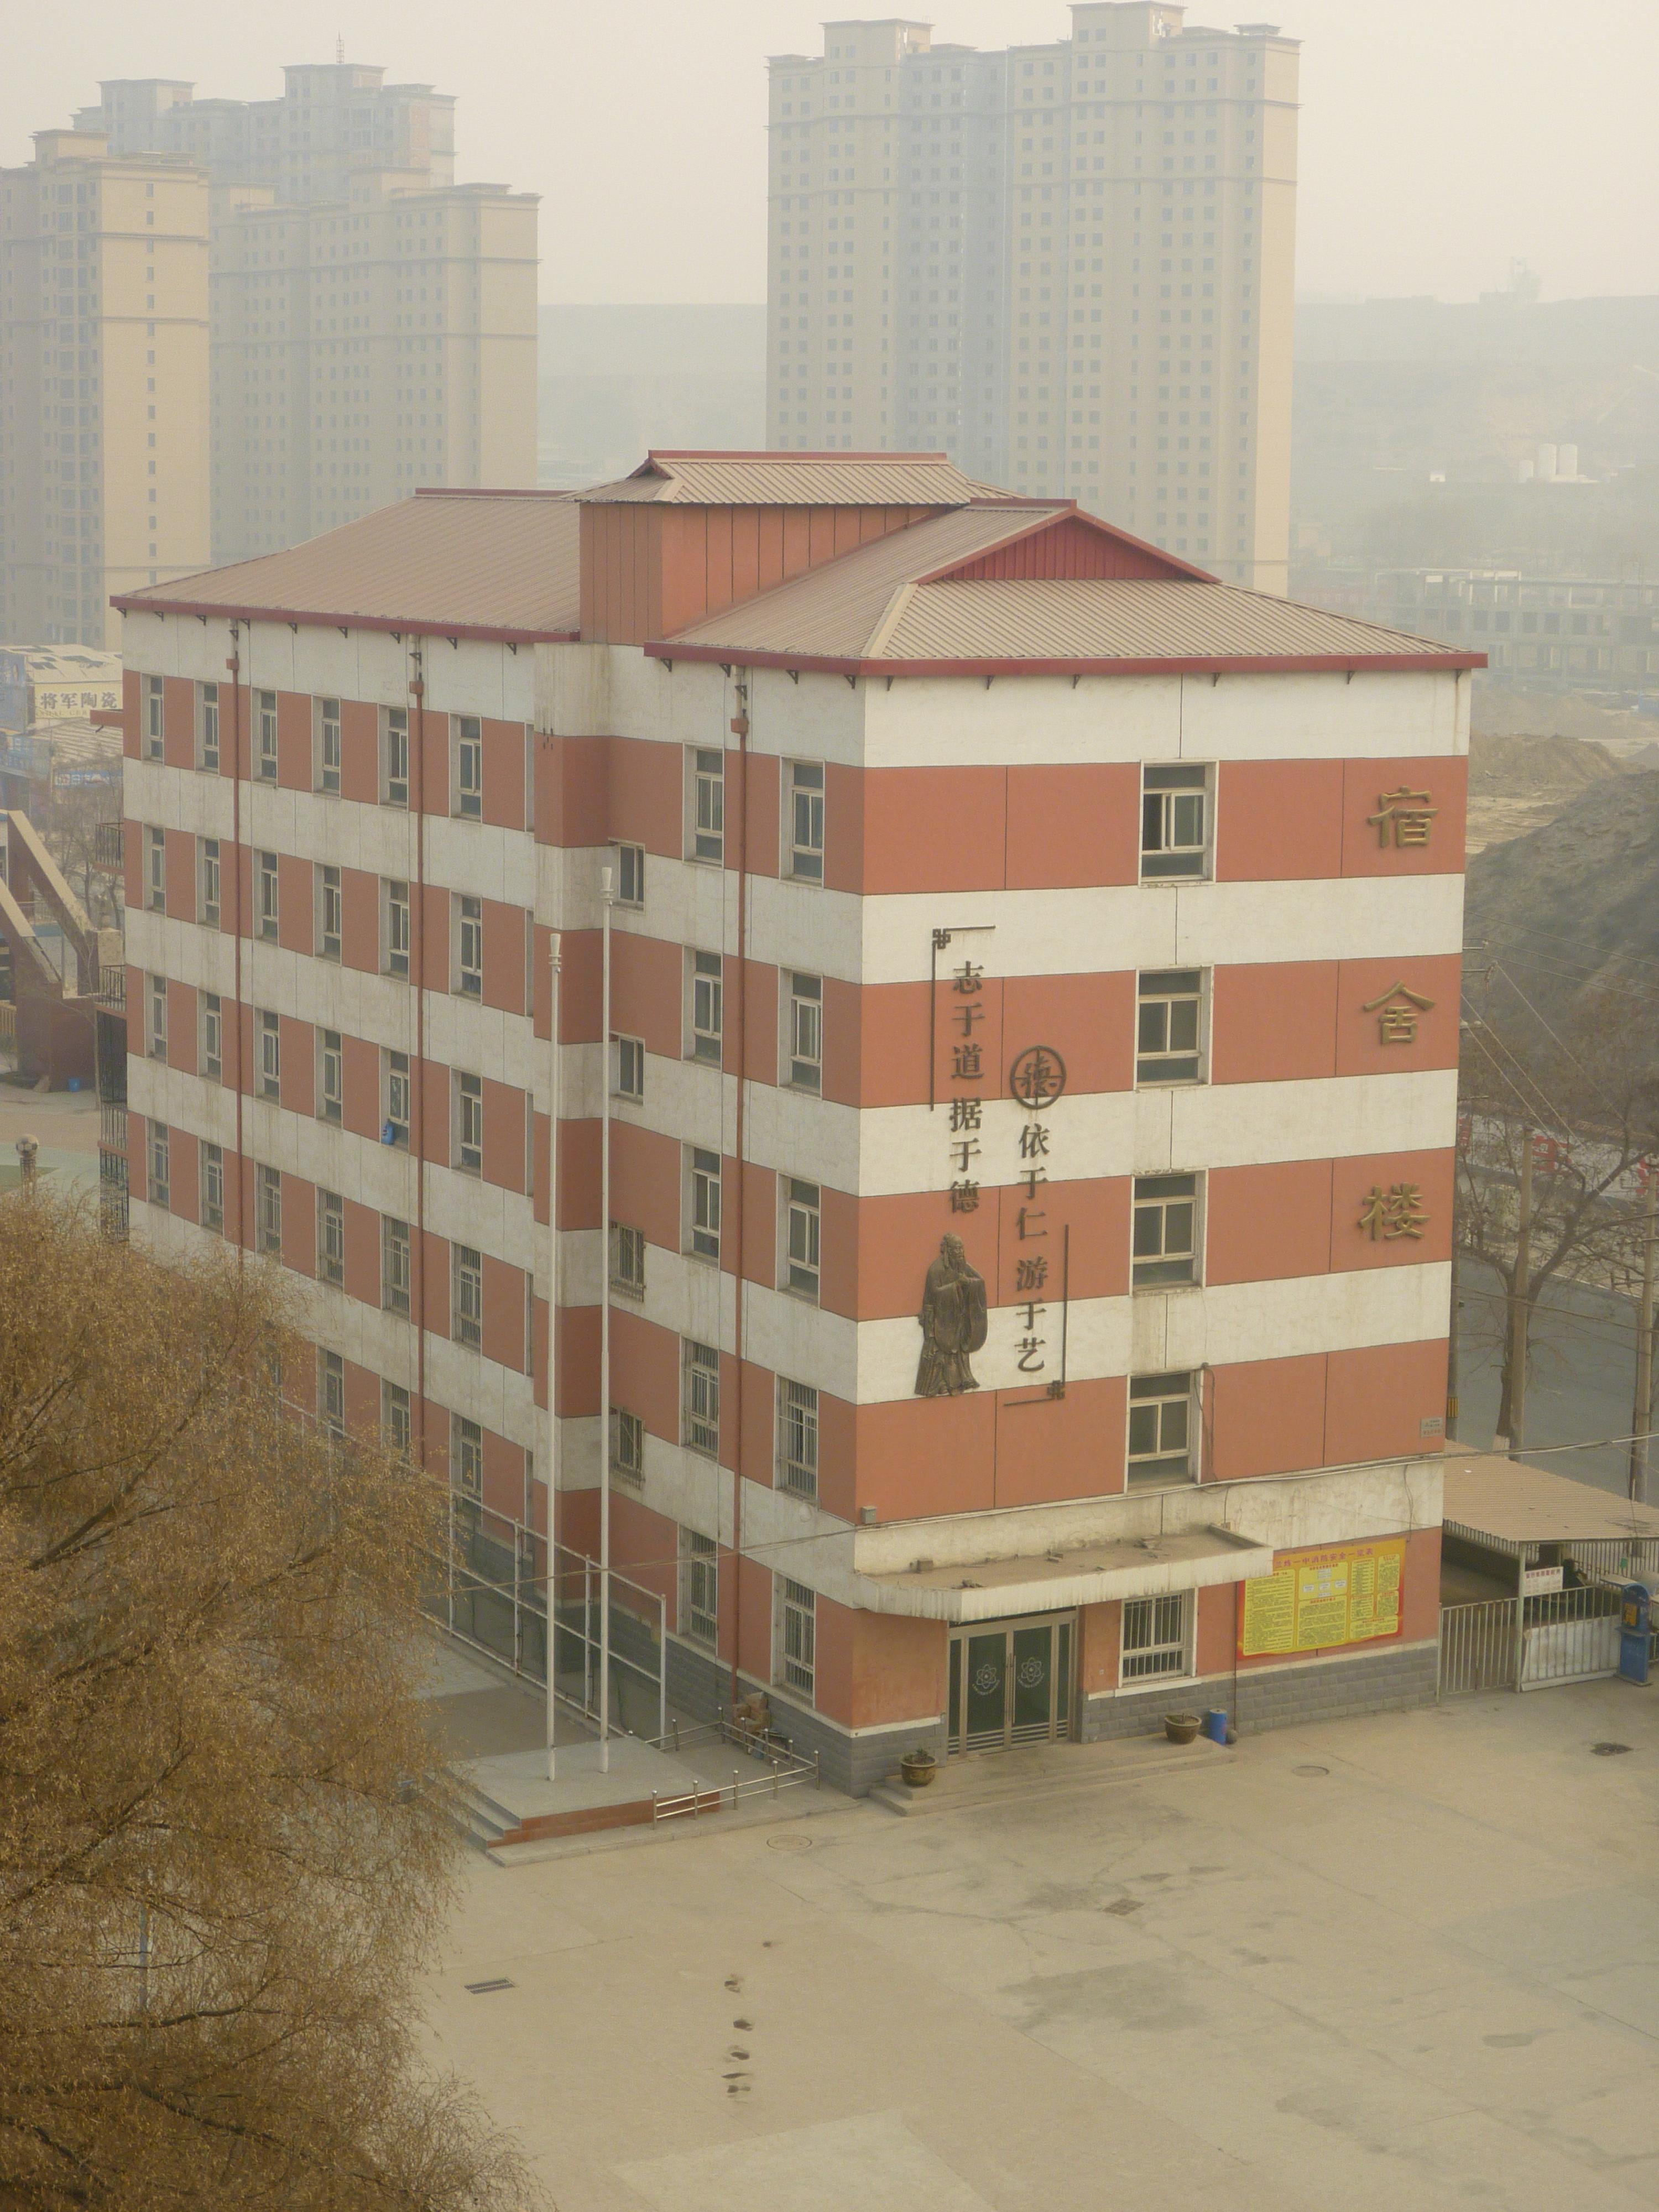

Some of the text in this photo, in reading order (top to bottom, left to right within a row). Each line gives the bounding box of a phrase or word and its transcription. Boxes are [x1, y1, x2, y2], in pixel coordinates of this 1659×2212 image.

[40, 692, 117, 709] 将军陶瓷
[949, 961, 985, 1214] 志于道据于德
[1014, 1123, 1051, 1372] 依于仁游于艺
